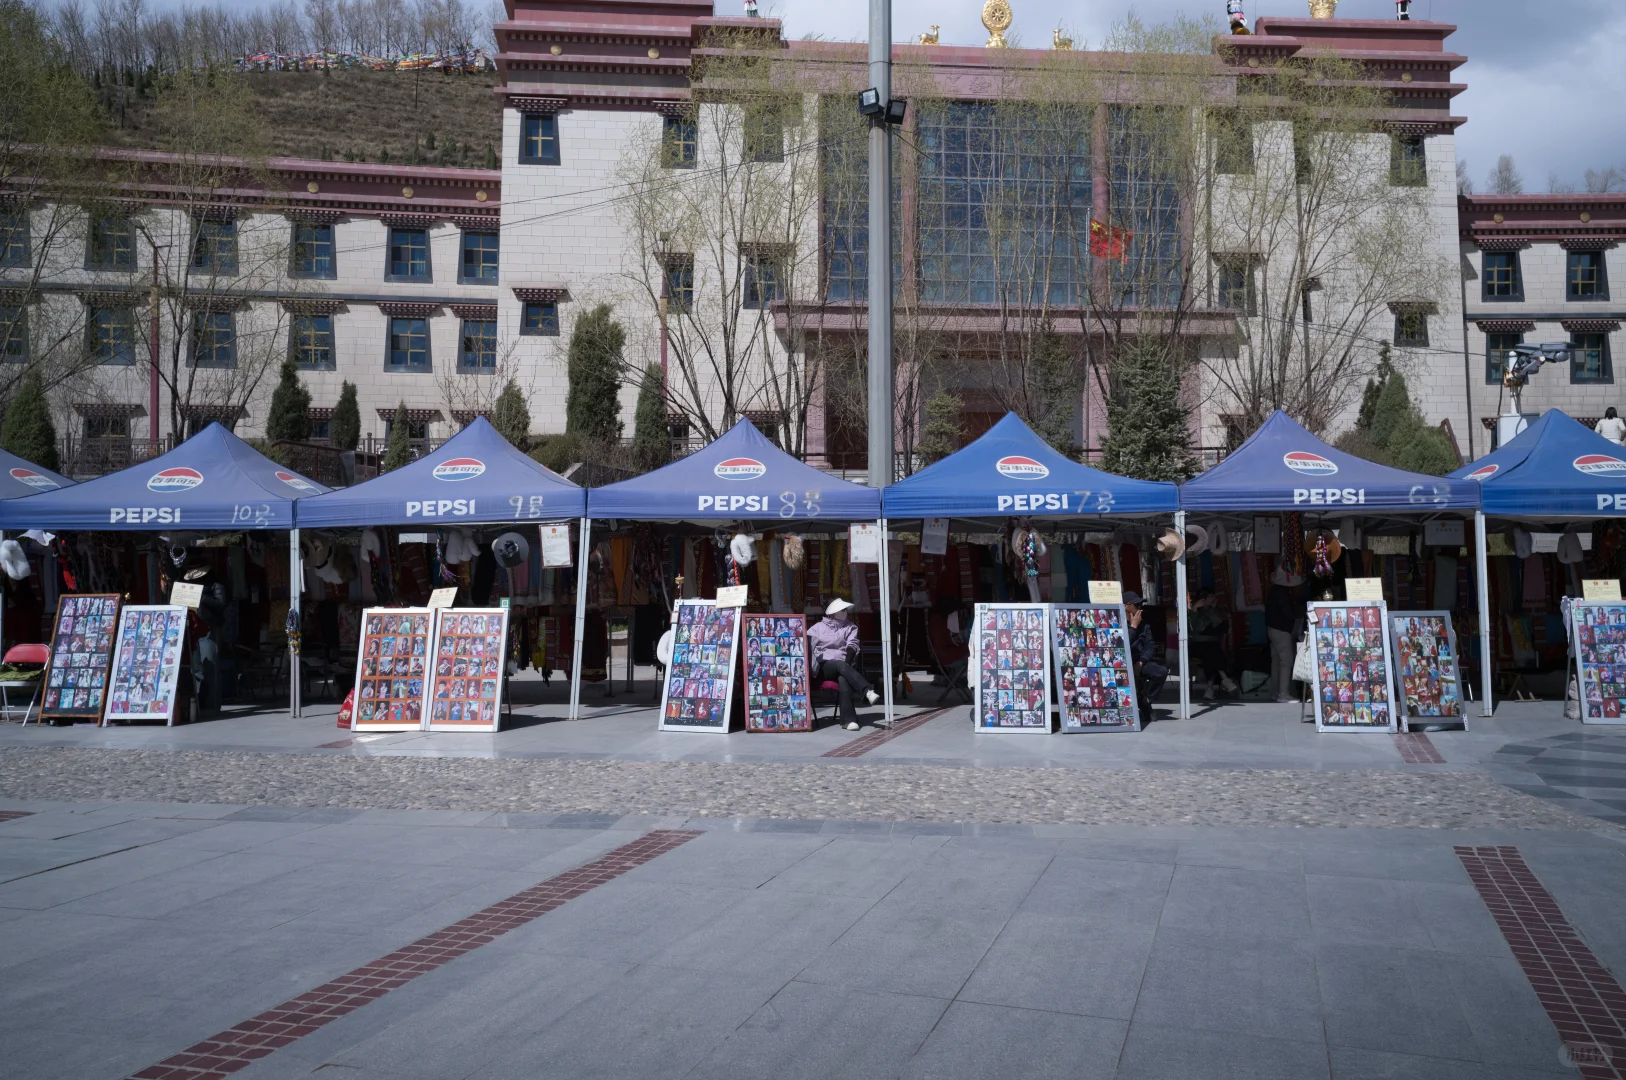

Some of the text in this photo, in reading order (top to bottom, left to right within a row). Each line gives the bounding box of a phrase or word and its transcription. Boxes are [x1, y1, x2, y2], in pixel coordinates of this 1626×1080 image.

[1287, 460, 1334, 469] 百事可乐
[151, 476, 199, 486] 百事可乐
[697, 495, 769, 512] PEPSI
[997, 493, 1069, 512] PEPSI
[1293, 488, 1365, 505] PEPSI
[109, 507, 181, 524] PEPSI
[406, 499, 476, 518] PEPSI
